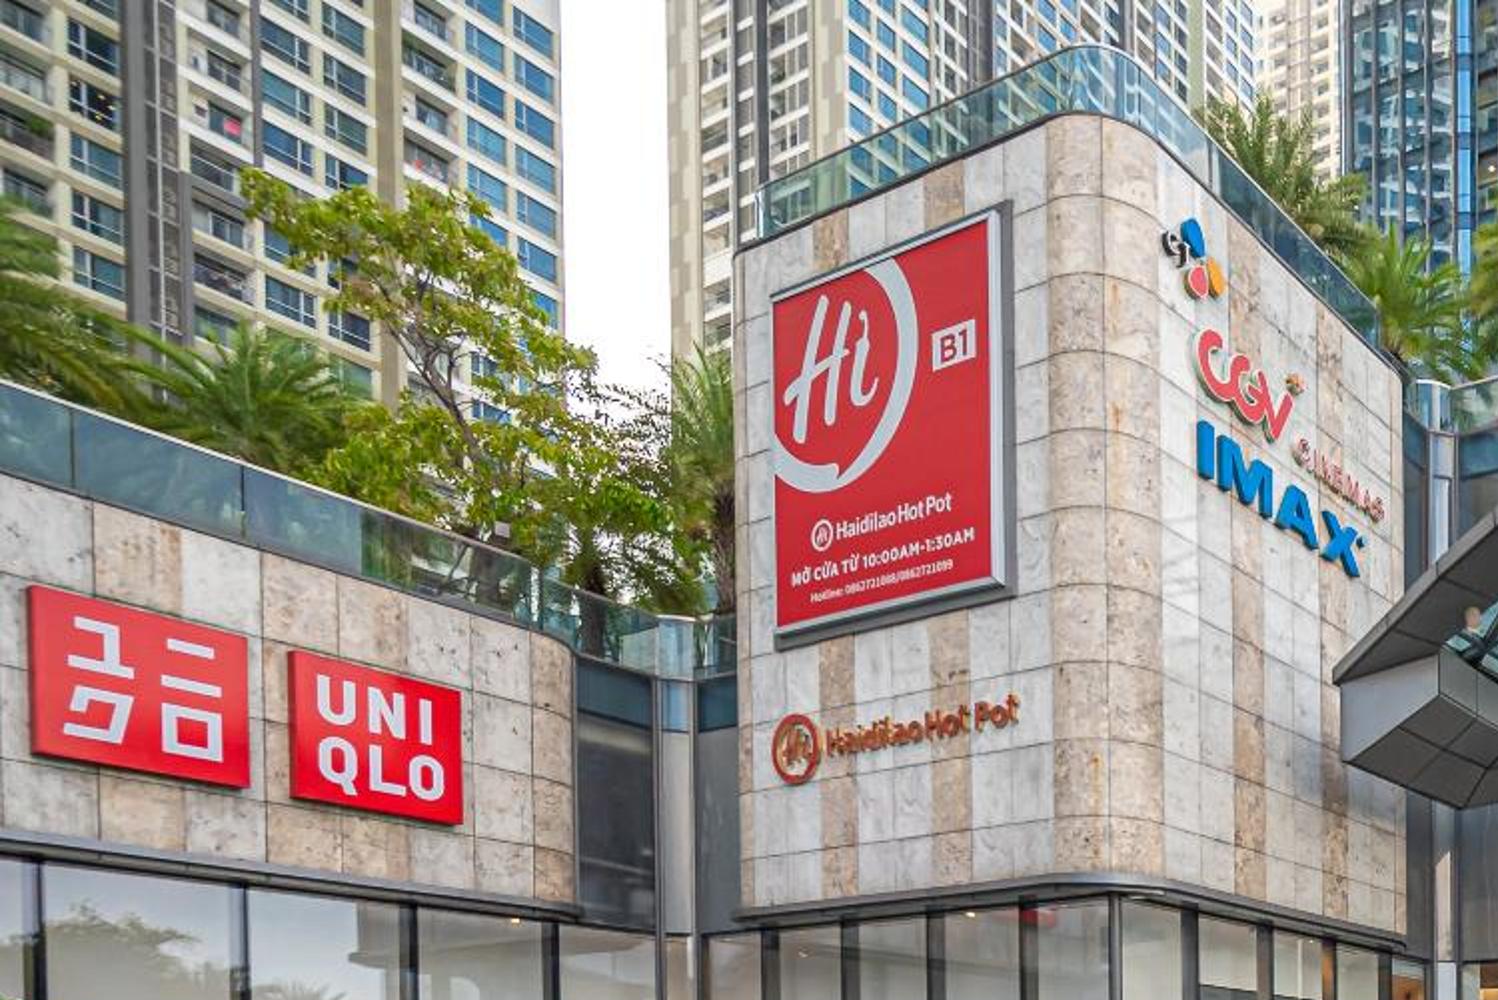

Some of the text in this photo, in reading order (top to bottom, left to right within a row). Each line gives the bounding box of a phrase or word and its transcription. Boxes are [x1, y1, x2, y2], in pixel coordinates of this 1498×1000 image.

[784, 295, 879, 444] Hi
[940, 329, 967, 363] B1
[1196, 329, 1293, 445] CGV
[836, 510, 897, 540] Haidilao
[898, 501, 925, 524] Hot
[926, 492, 952, 516] Pot
[1196, 420, 1361, 578] IMAX
[1292, 438, 1384, 523] CINEMAS
[316, 675, 433, 746] UNI
[826, 716, 924, 758] Haidilao
[925, 704, 971, 742] Hot
[974, 693, 1020, 733] Pot
[318, 736, 445, 801] QLO
